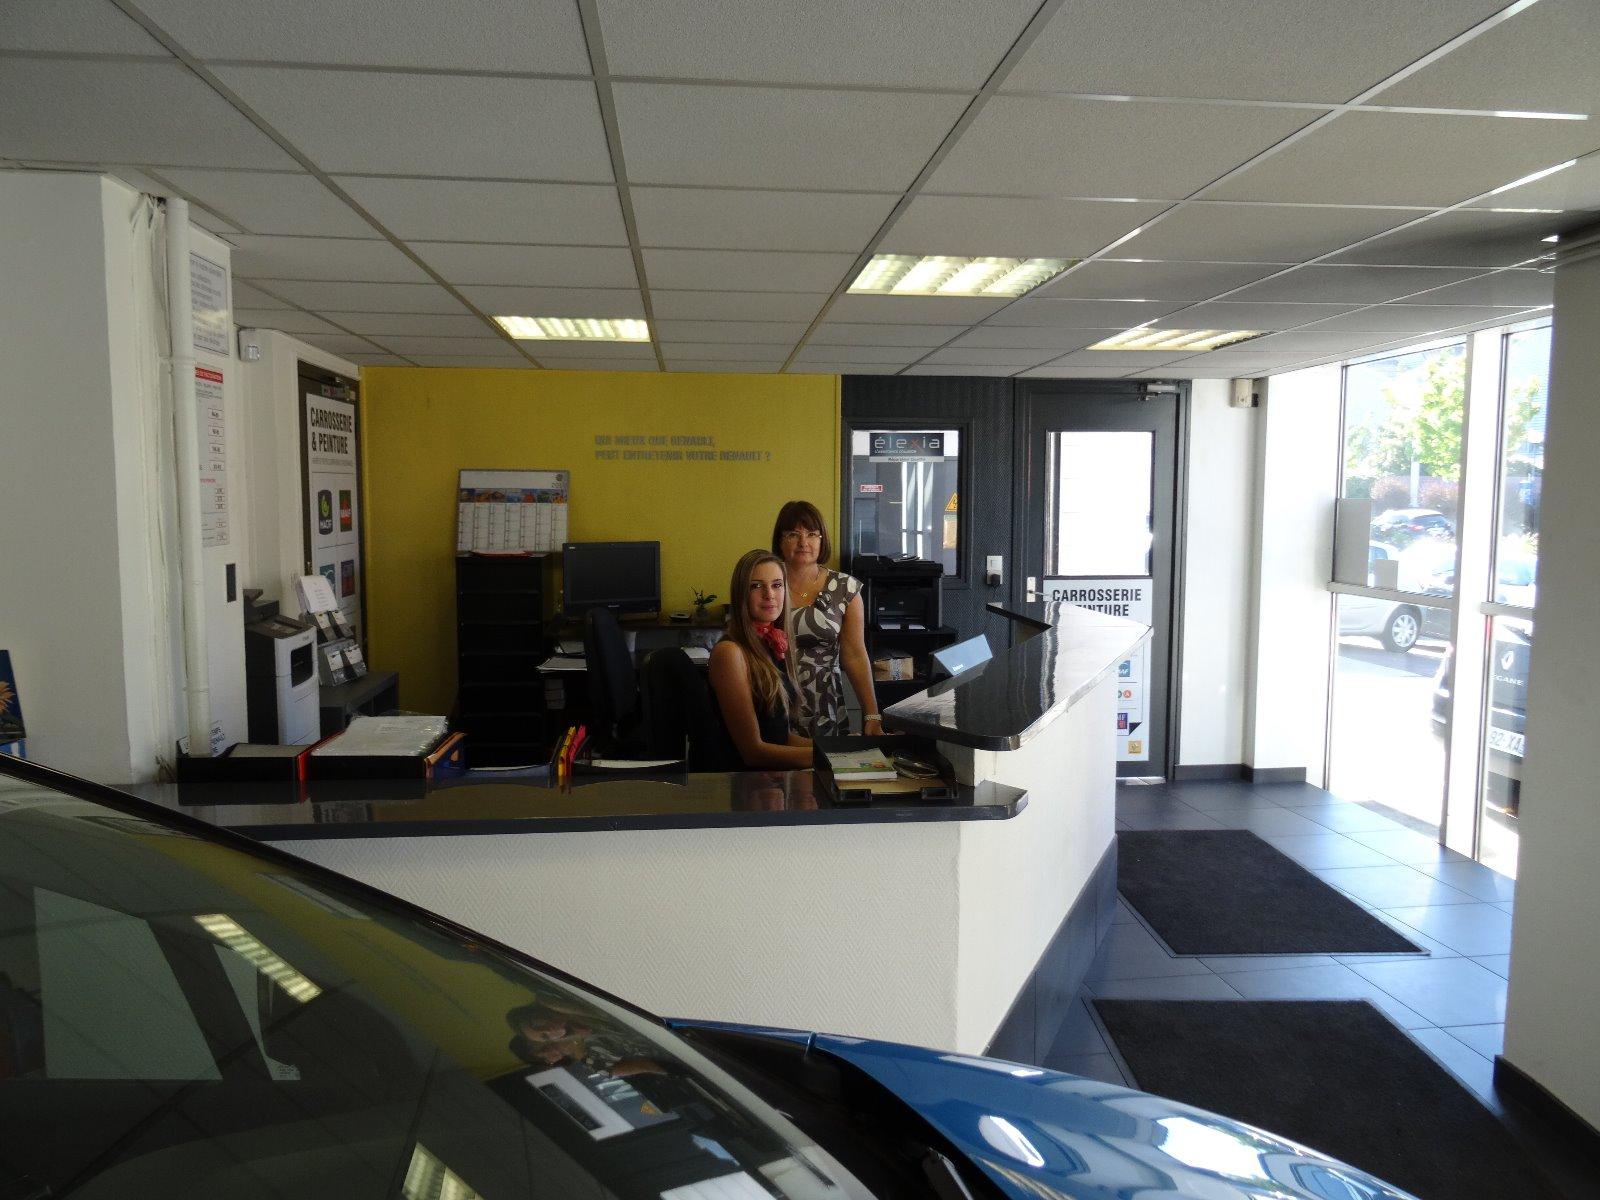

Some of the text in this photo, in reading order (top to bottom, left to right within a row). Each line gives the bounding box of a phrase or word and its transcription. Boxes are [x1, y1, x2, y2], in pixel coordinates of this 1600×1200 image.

[310, 407, 353, 433] CARROSSERIE
[311, 433, 348, 454] & PEINTURE
[1052, 589, 1142, 602] CARROSSERIE
